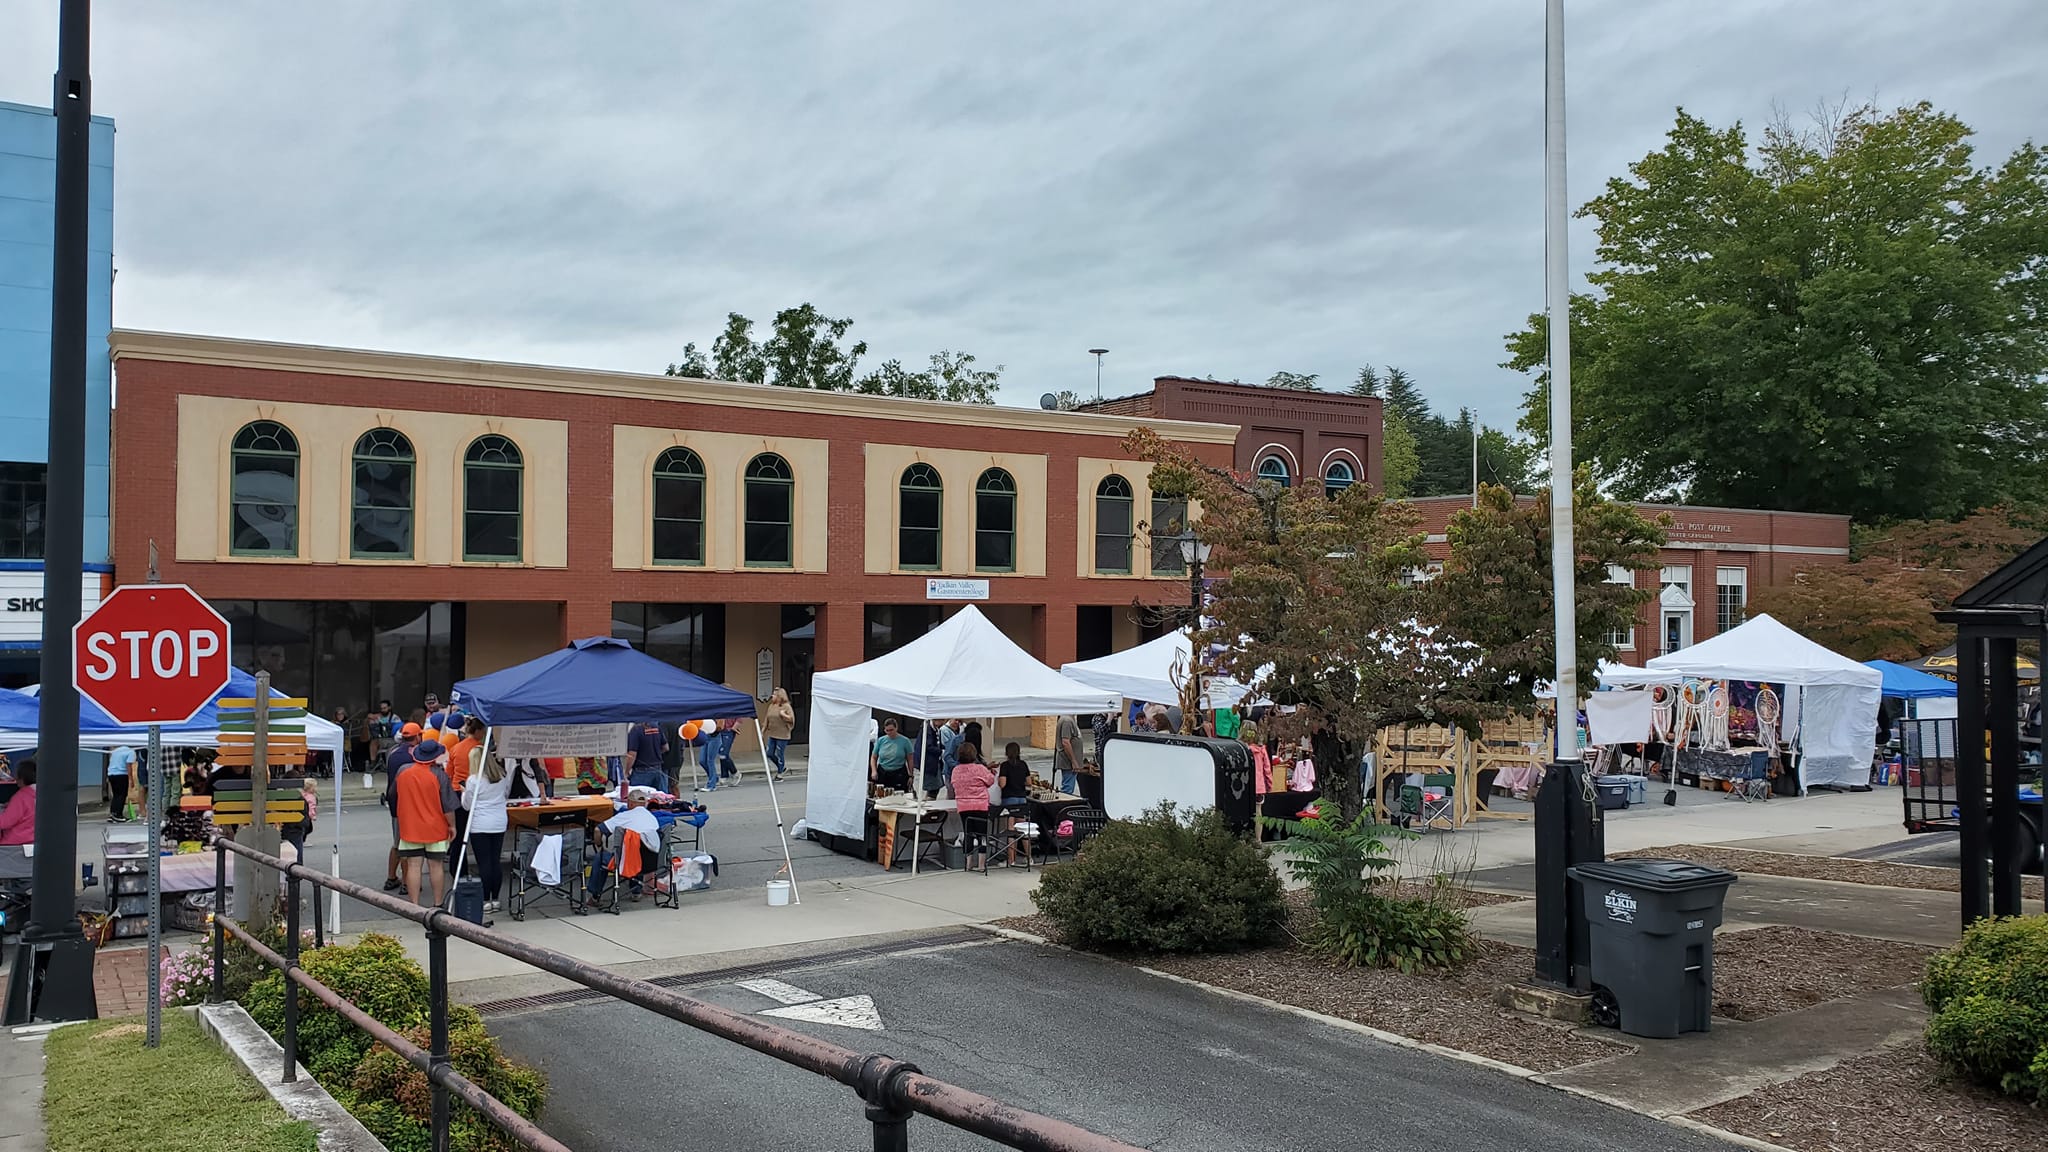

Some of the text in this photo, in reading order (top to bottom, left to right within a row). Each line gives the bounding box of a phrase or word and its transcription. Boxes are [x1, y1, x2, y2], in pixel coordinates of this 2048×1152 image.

[1688, 523, 1705, 531] POST
[1708, 524, 1732, 533] OFFICE
[958, 581, 976, 589] Valley
[7, 597, 45, 612] SHO
[85, 629, 219, 681] STOP
[1604, 895, 1638, 910] ELKIN
